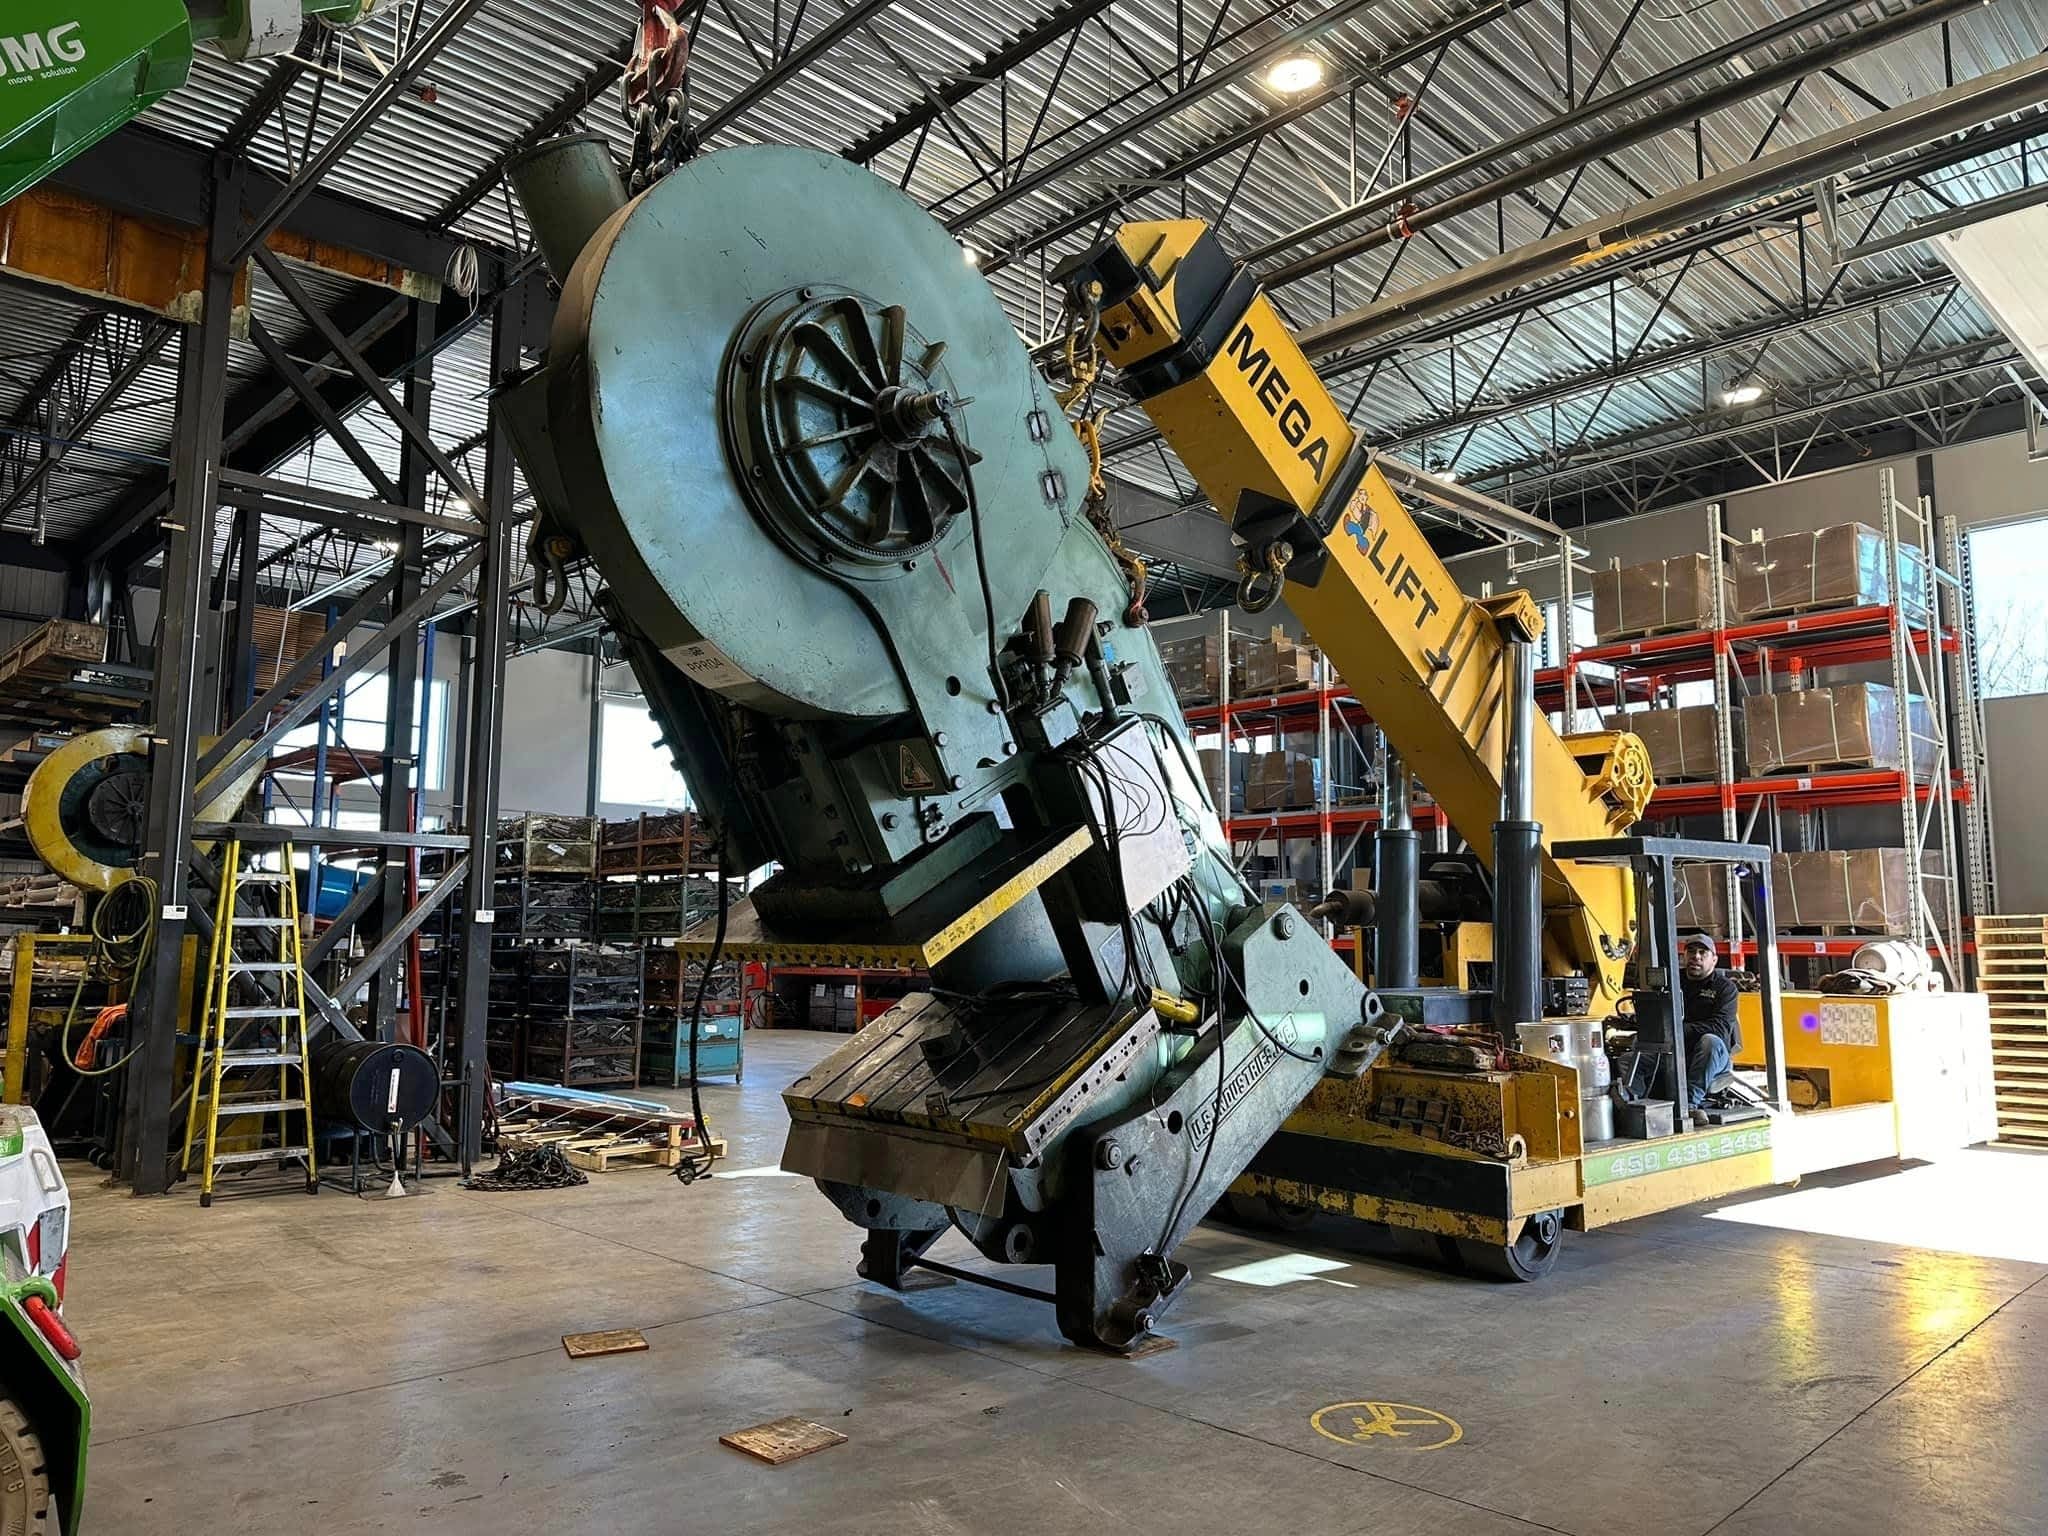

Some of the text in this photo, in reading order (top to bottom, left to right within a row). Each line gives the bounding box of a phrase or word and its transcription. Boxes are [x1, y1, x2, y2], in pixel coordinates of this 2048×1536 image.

[8, 66, 77, 85] move solution
[1226, 323, 1329, 484] MEGA
[1368, 529, 1440, 628] LIFT
[1610, 1151, 1660, 1177] 450
